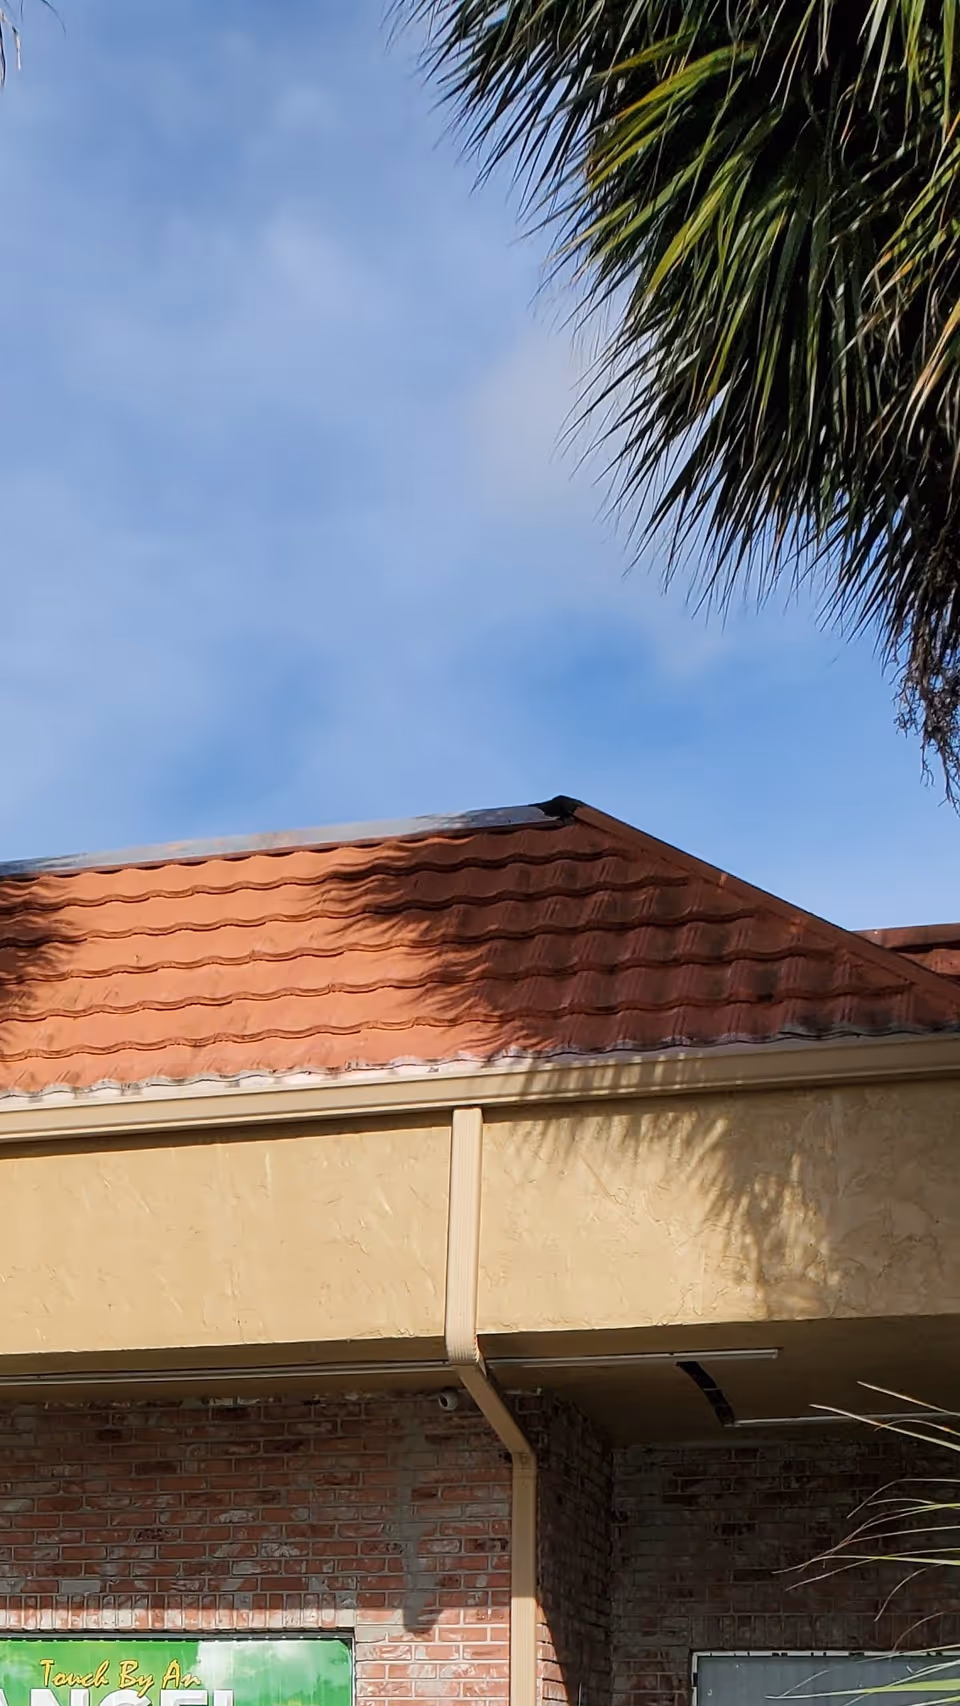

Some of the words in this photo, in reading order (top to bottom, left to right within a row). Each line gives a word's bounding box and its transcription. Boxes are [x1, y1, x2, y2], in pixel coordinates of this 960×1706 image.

[40, 1659, 110, 1688] Touch
[119, 1659, 154, 1696] By
[161, 1659, 201, 1688] An
